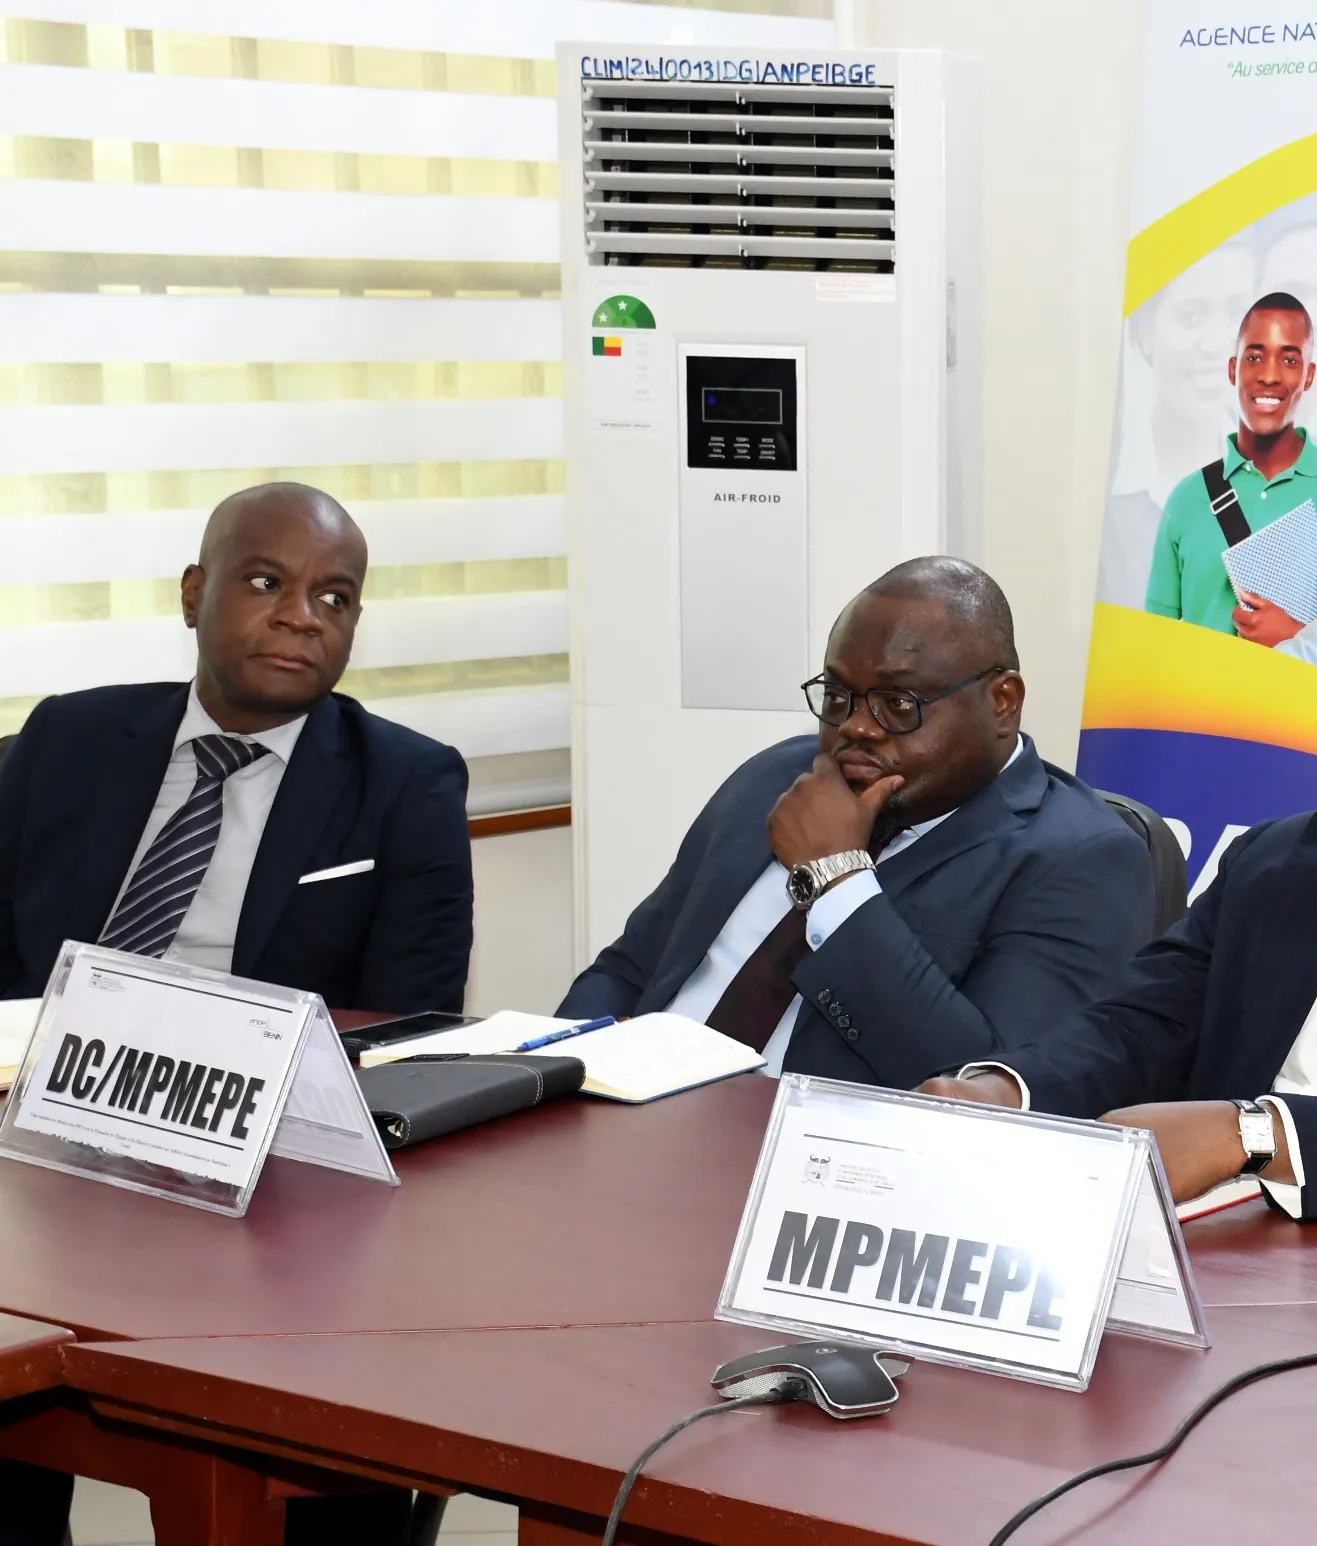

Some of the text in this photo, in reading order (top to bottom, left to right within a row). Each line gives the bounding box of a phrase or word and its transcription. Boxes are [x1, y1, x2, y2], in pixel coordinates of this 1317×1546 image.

[1180, 26, 1275, 47] AGENCE
[1254, 59, 1305, 76] service
[713, 493, 781, 504] AIR-FROID
[46, 1032, 266, 1141] DC/MPMEPE
